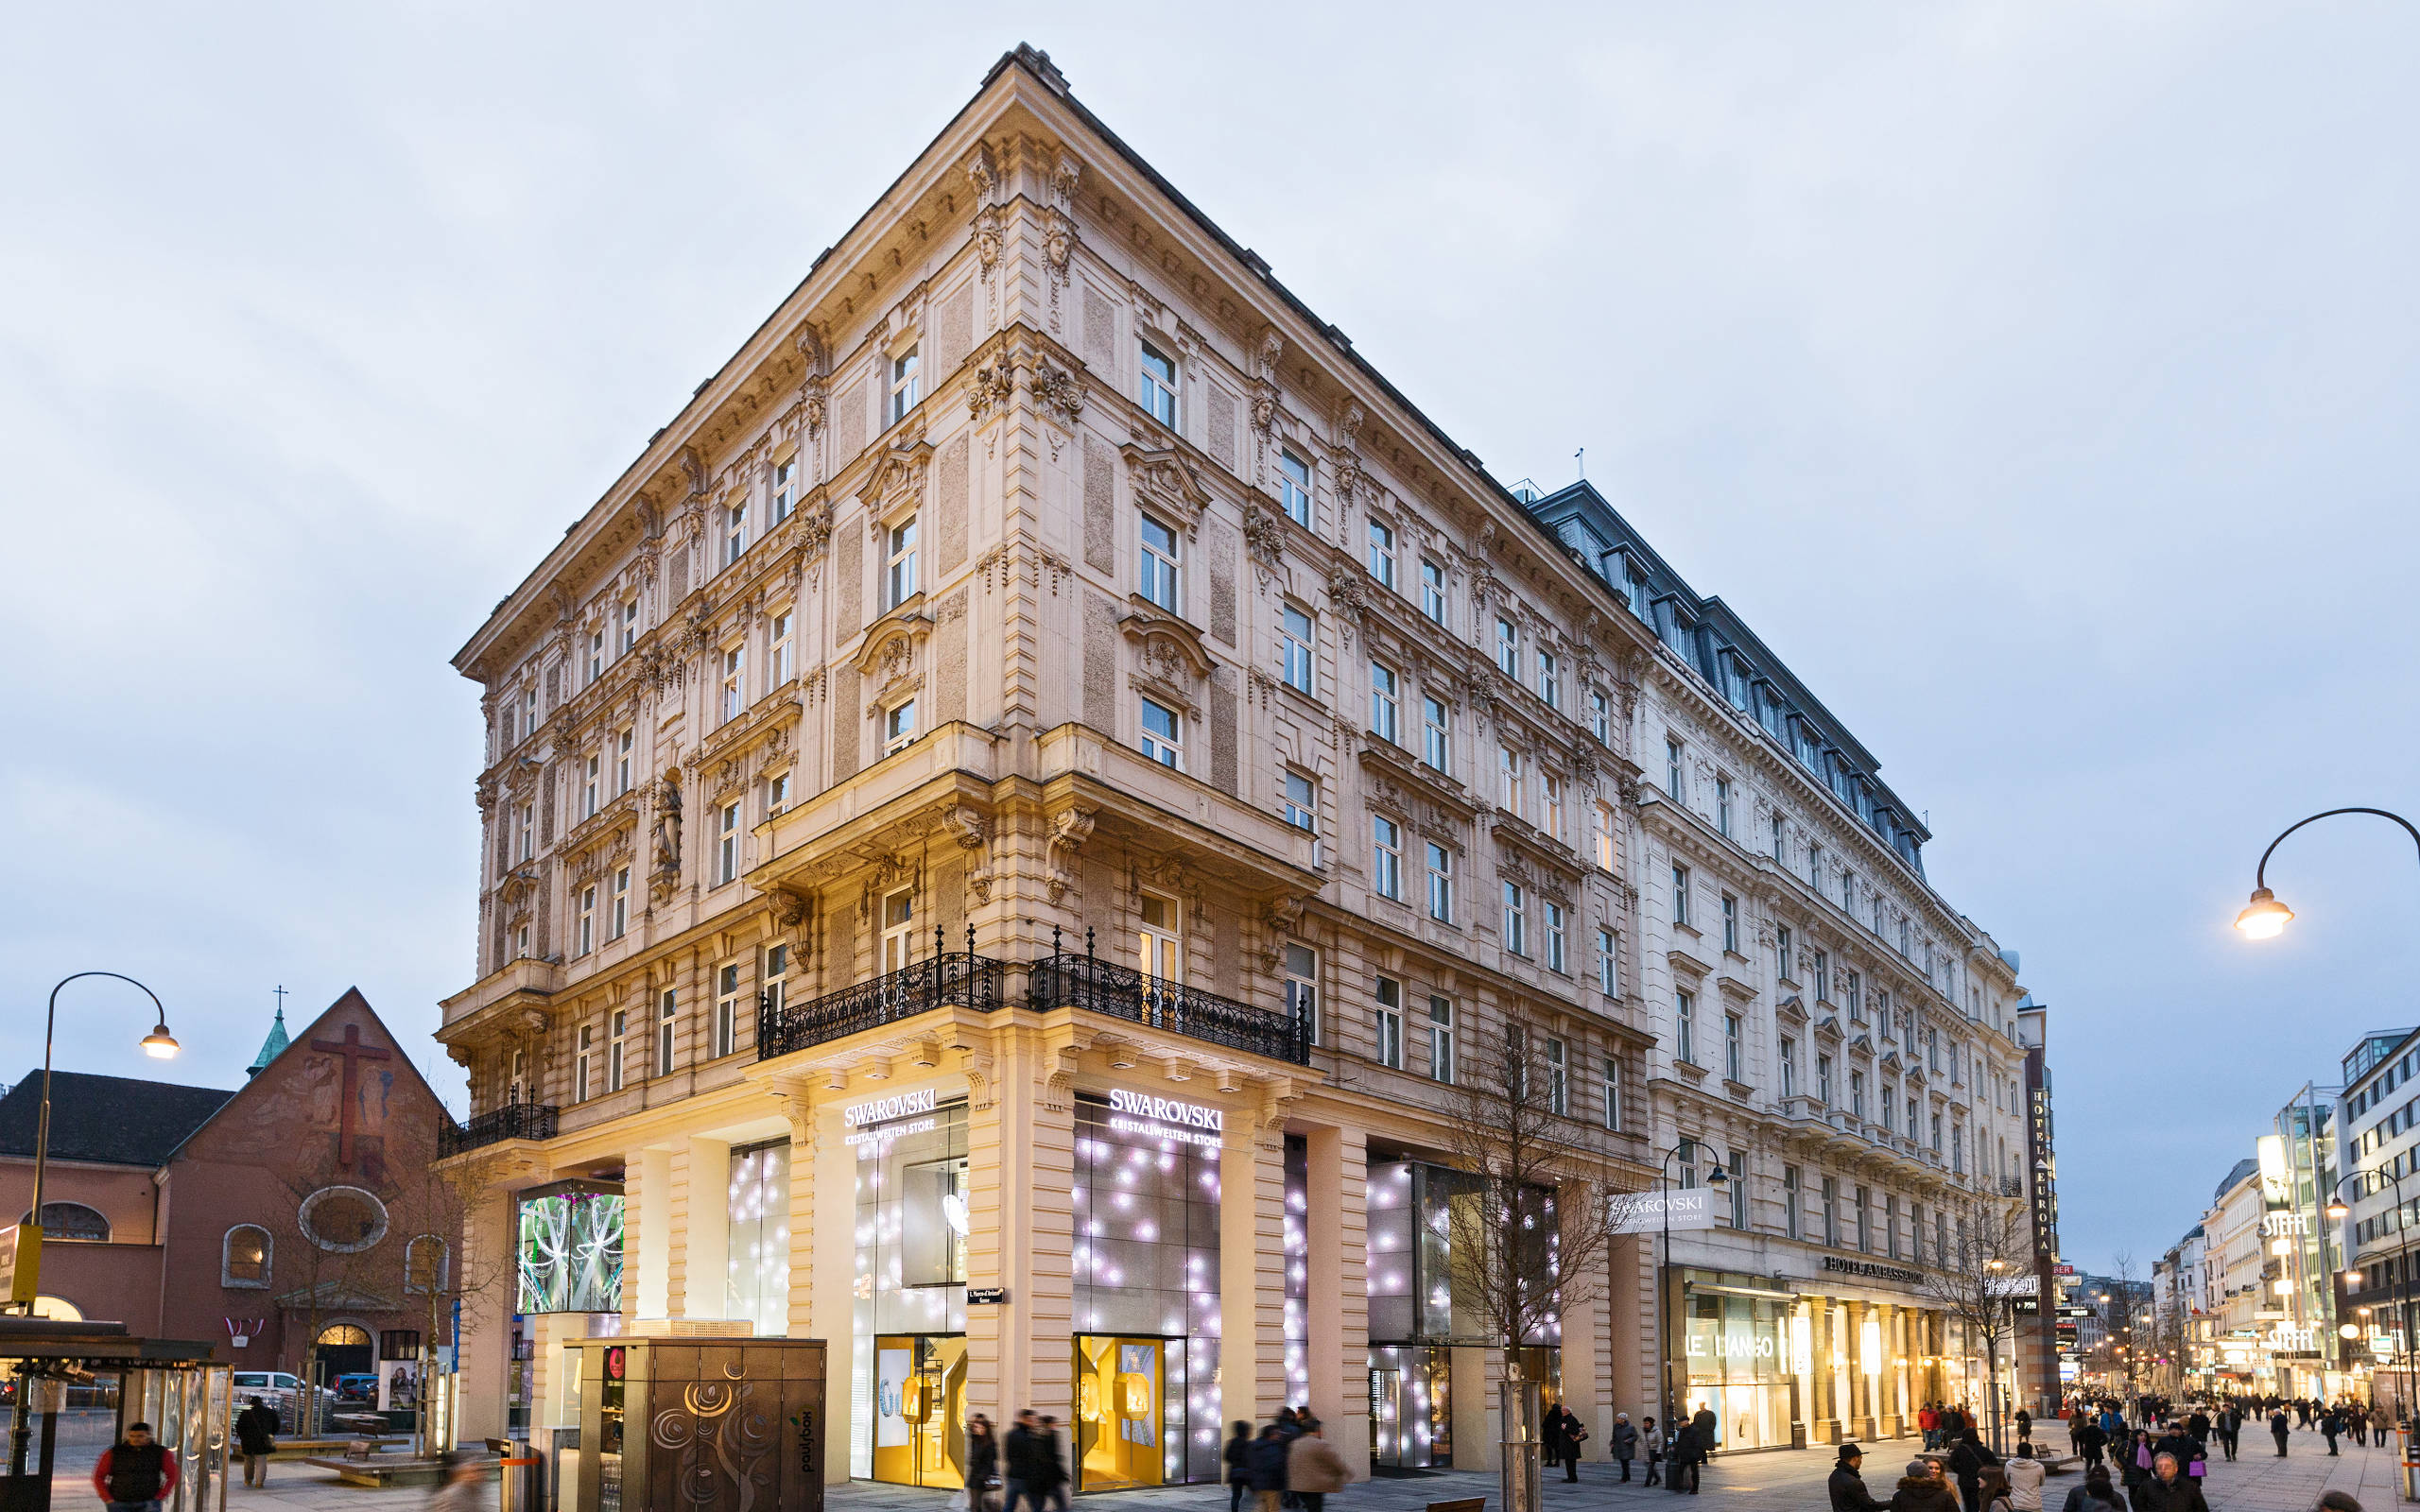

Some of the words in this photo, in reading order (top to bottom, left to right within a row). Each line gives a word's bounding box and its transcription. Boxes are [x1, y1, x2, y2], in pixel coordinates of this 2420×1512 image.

[845, 1089, 935, 1127] SWAROVSKI
[1110, 1089, 1222, 1130] SWAROVSKI
[845, 1125, 907, 1145] KRISTALLWELTEN
[908, 1119, 935, 1134] STORE
[1110, 1118, 1191, 1143] KRISTALLWELTEN
[1194, 1134, 1222, 1148] STORE
[2033, 1091, 2045, 1155] HOTEL
[1611, 1196, 1703, 1215] SWAROVSKI
[2037, 1172, 2048, 1250] EUROPA
[1612, 1215, 1675, 1226] TALLWELTN
[1678, 1213, 1703, 1222] STORE
[2263, 1214, 2310, 1236] STEFFL
[1830, 1256, 1864, 1275] HOTEL
[2268, 1327, 2316, 1351] STEFFL
